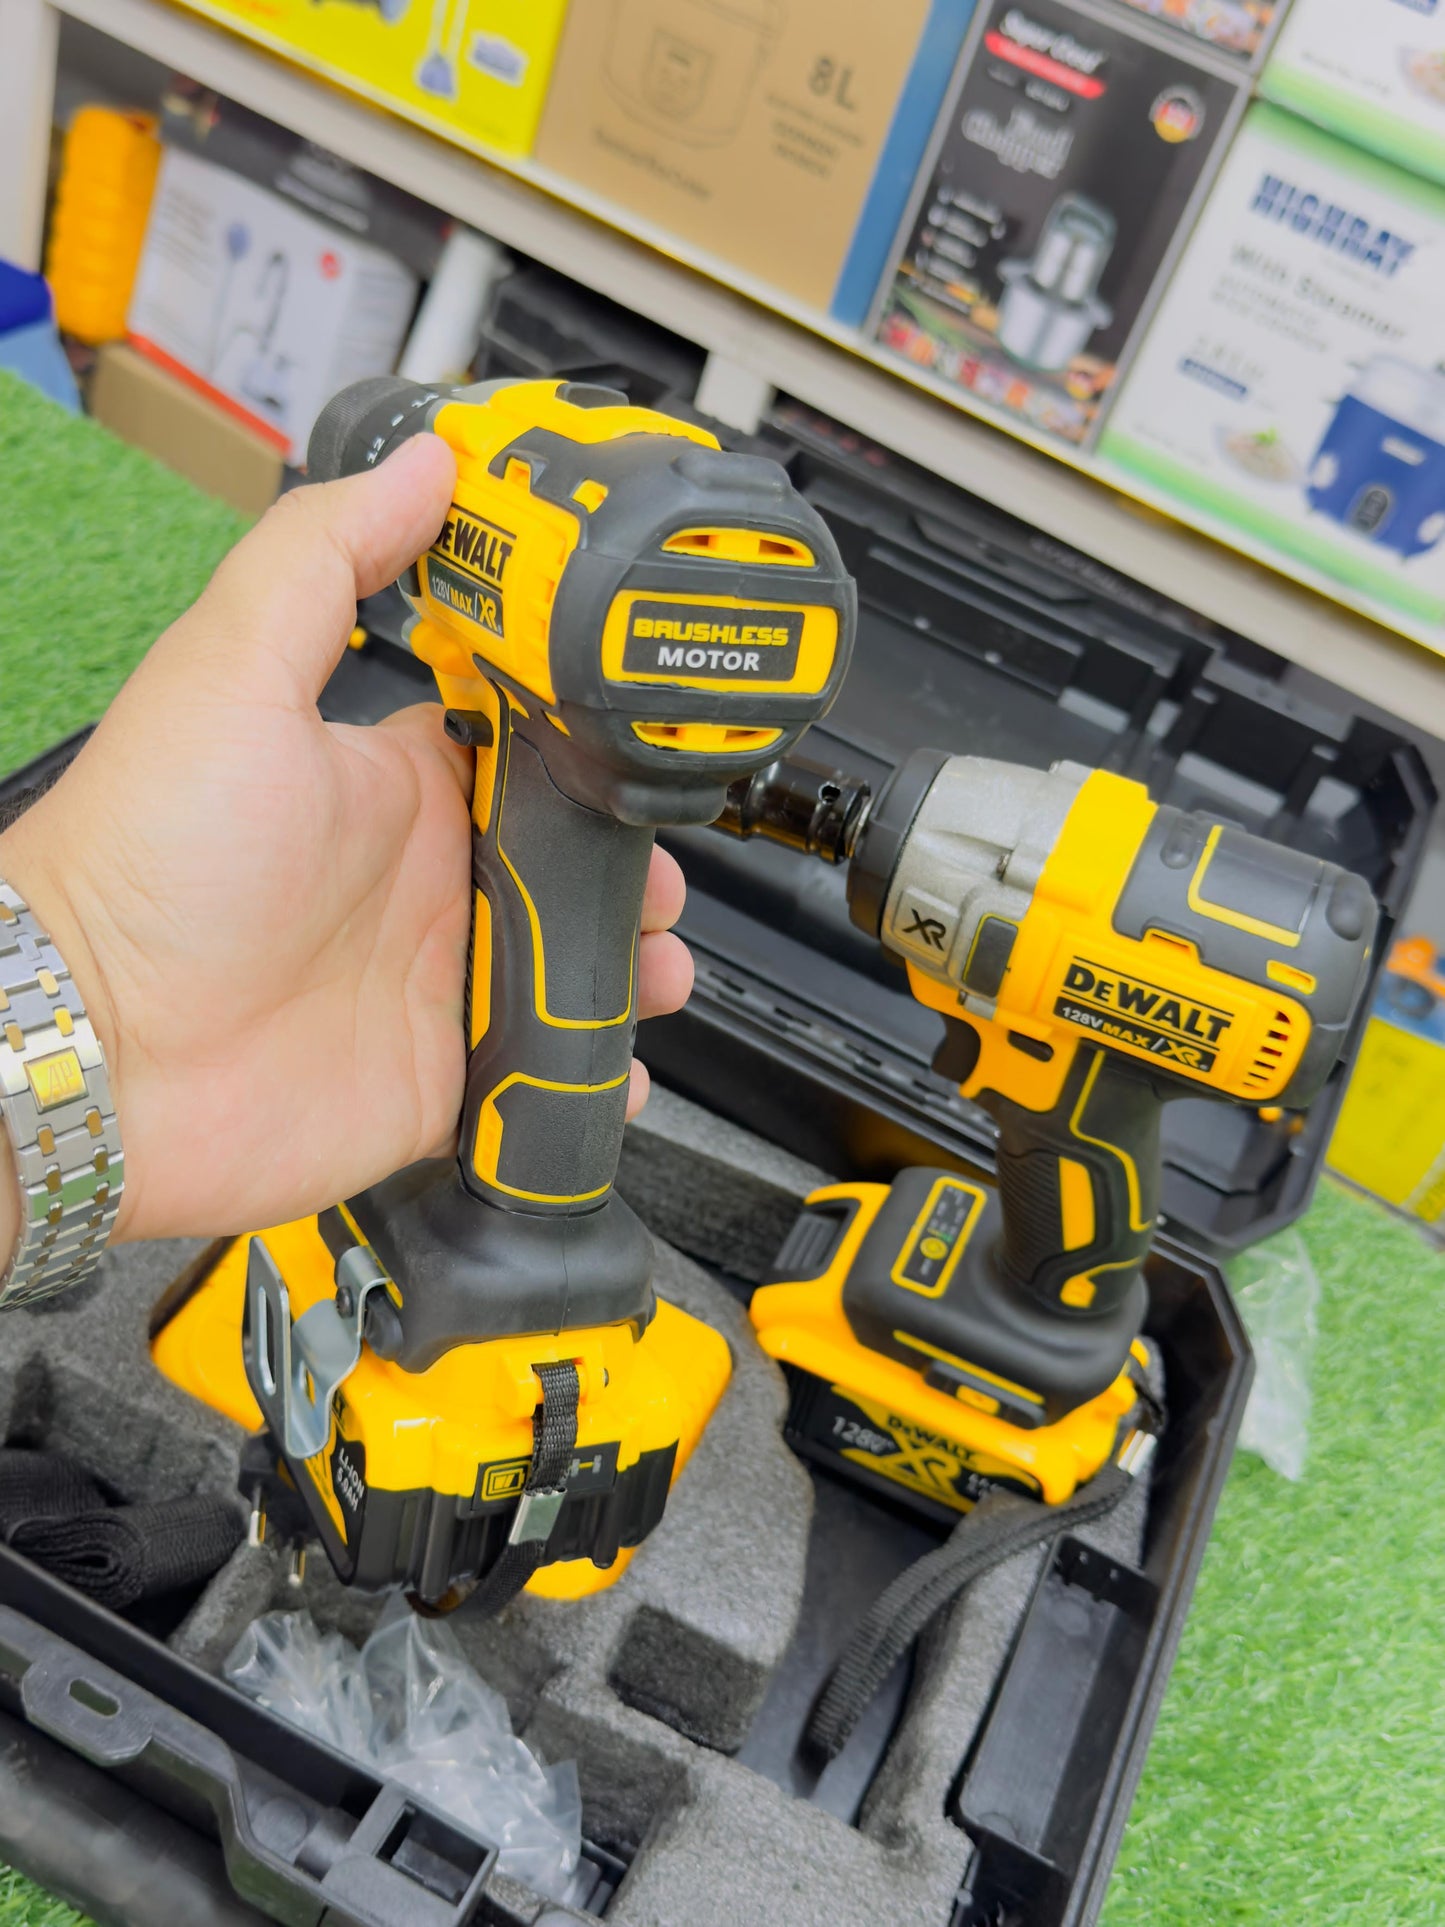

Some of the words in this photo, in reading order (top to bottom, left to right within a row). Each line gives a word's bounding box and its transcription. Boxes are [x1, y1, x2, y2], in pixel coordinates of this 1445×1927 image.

[434, 517, 514, 583] EWALT
[632, 617, 790, 647] BRUSHLESS
[657, 646, 761, 672] MOTOR
[1062, 1005, 1105, 1030] 128V
[1102, 1022, 1151, 1050] MAX
